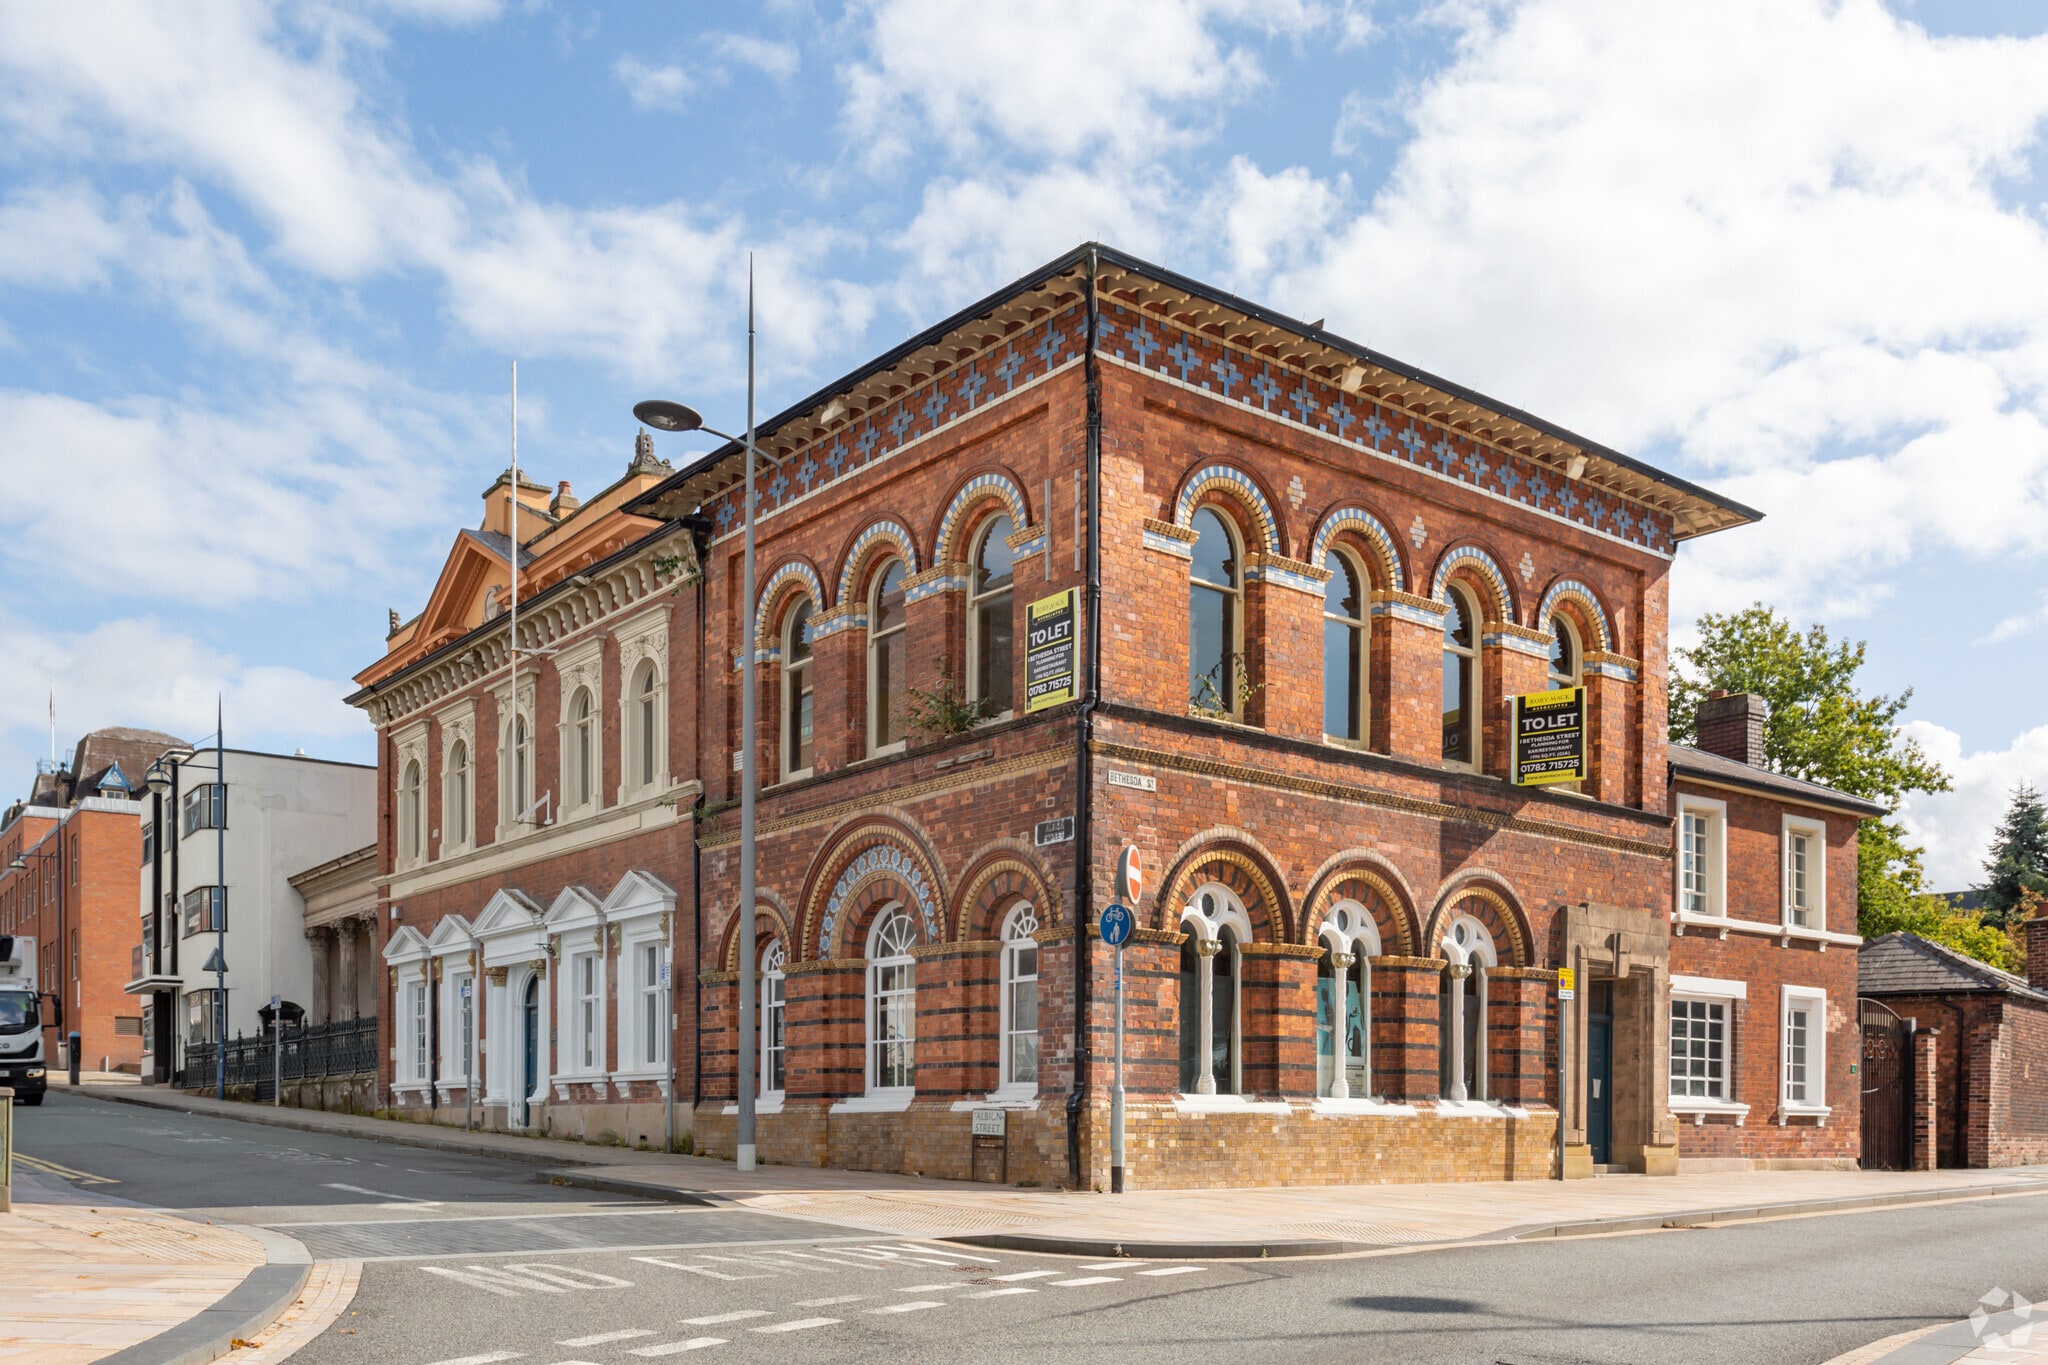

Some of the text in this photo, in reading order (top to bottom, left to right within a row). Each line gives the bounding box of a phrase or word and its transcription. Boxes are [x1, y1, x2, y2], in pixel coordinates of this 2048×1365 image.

[1030, 621, 1071, 646] TO LET
[1030, 649, 1052, 662] BETHESDA
[1054, 643, 1072, 654] STREET
[1028, 676, 1071, 696] 01782 715725
[1522, 713, 1577, 730] TO LET
[1523, 735, 1555, 743] BETHESDA
[1521, 759, 1579, 773] 01782 715725
[1110, 772, 1142, 786] BETHESDA
[976, 1112, 1002, 1121] ALBION
[976, 1123, 1000, 1132] STREET
